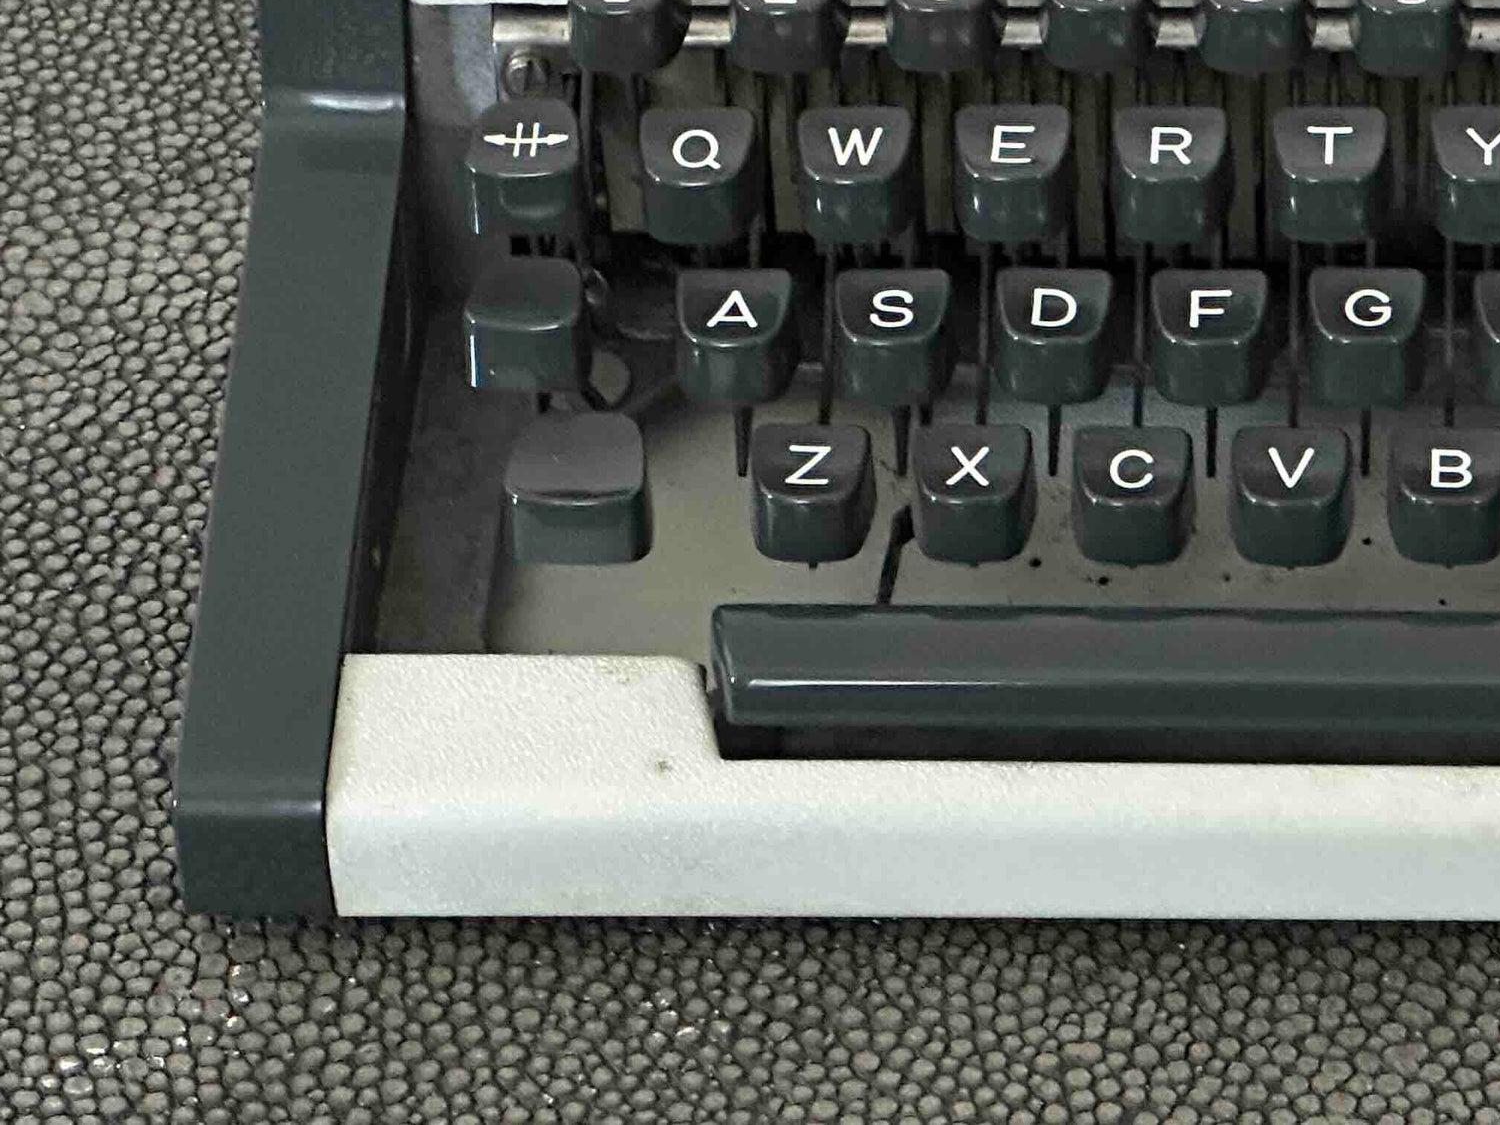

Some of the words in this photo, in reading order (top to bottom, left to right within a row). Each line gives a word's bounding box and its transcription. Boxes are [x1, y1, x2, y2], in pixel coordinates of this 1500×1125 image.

[672, 129, 722, 170] Q
[827, 126, 884, 166] W
[990, 124, 1036, 164] E
[1149, 126, 1193, 165] R
[1306, 125, 1354, 166] T
[706, 289, 758, 328] A
[869, 289, 914, 328] S
[1030, 287, 1077, 327] D
[1189, 289, 1233, 328] F
[1344, 288, 1392, 327] G
[784, 444, 832, 485] Z
[945, 446, 990, 487] X
[1109, 449, 1154, 489] C
[1268, 446, 1315, 489] V
[1430, 448, 1473, 489] B
